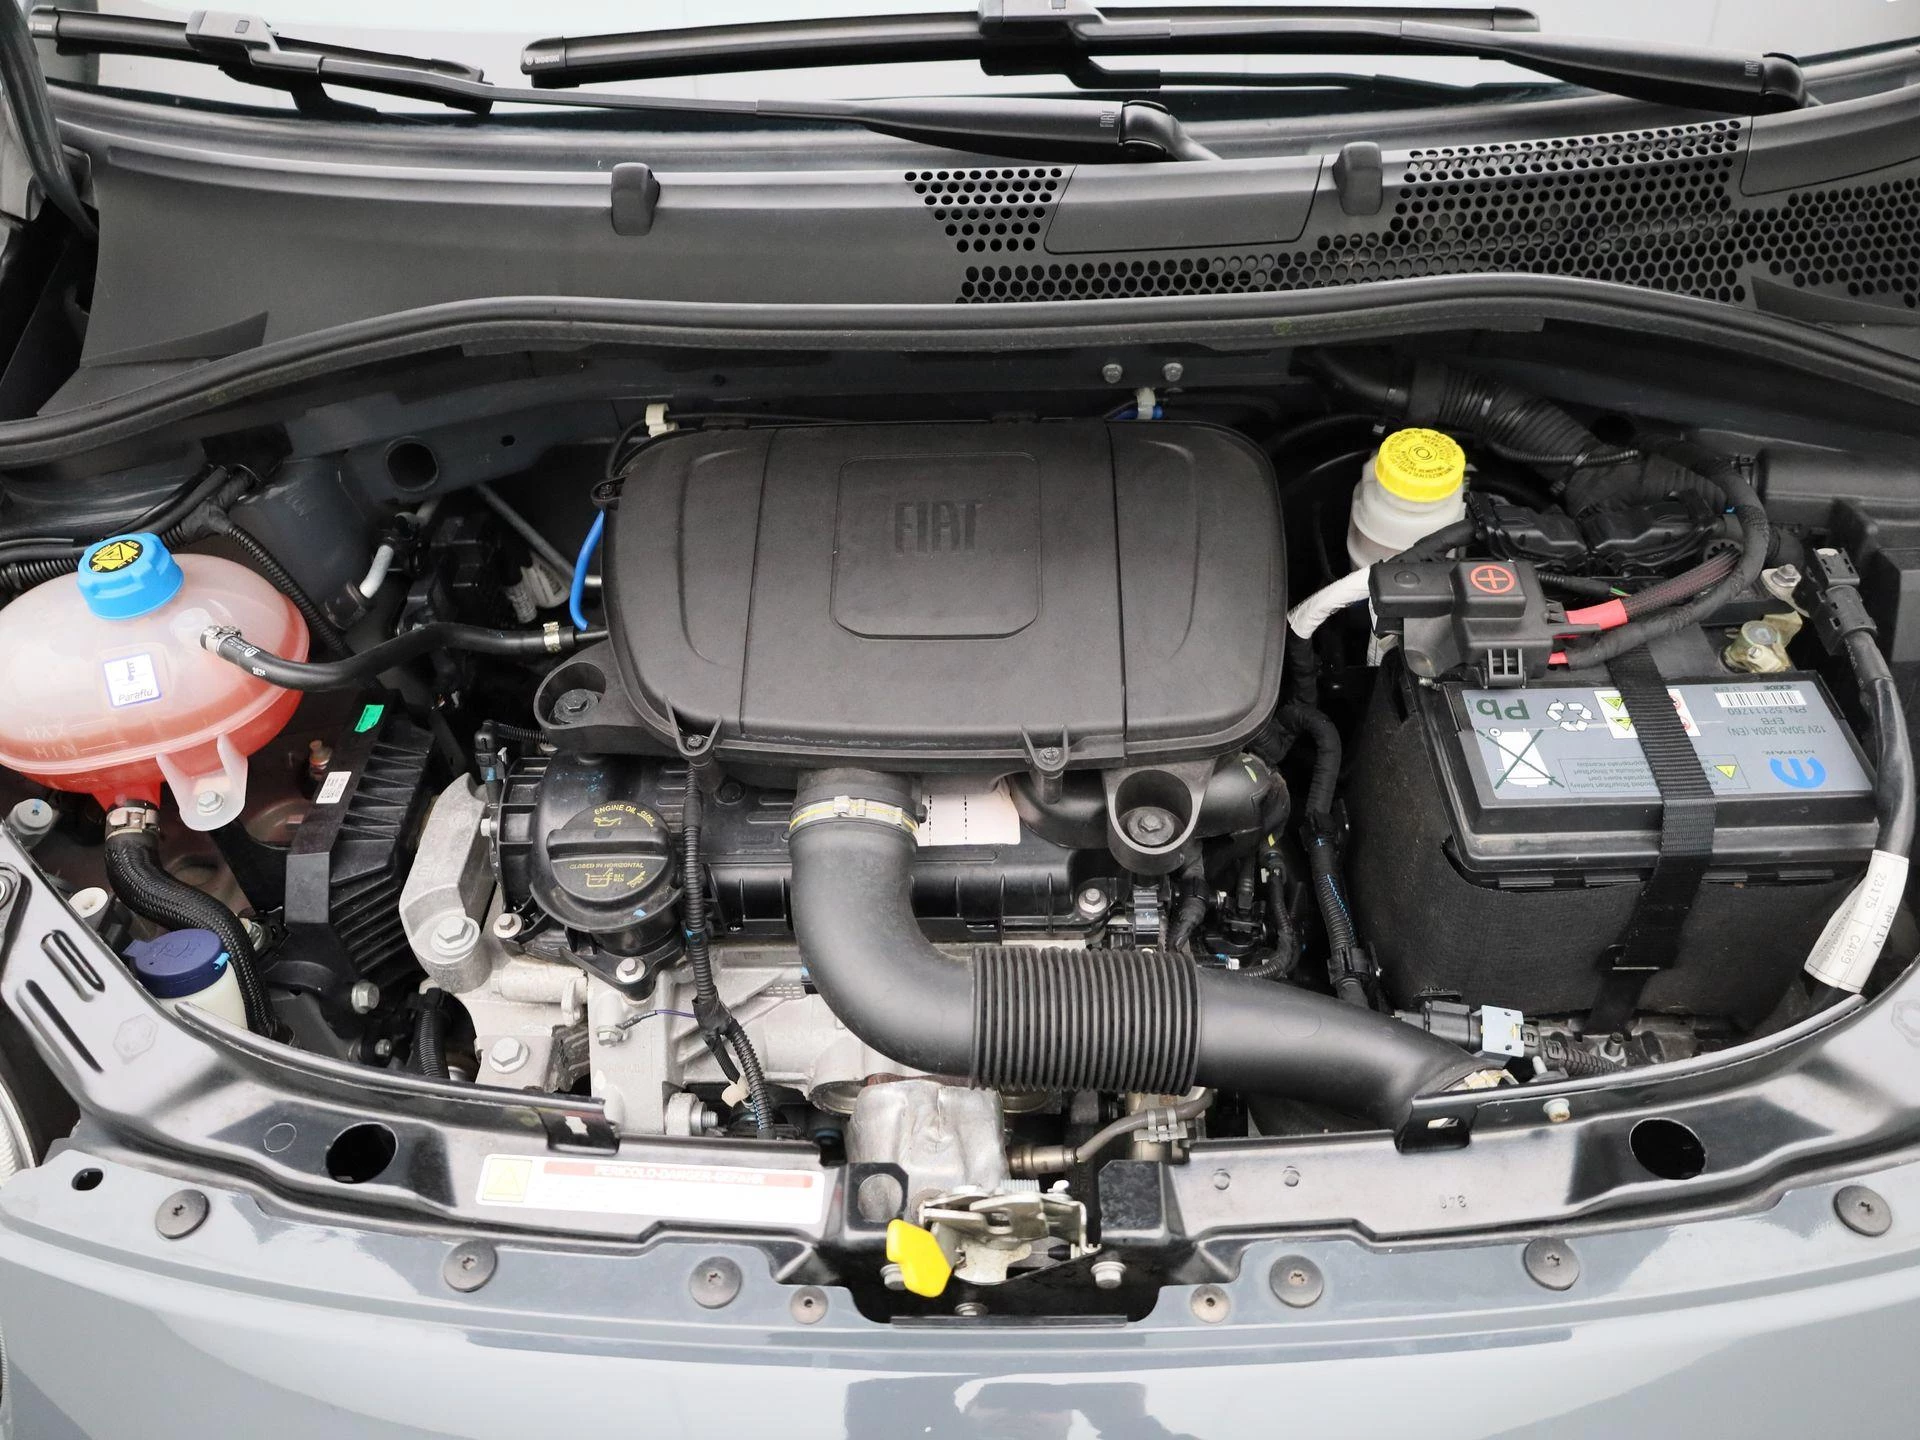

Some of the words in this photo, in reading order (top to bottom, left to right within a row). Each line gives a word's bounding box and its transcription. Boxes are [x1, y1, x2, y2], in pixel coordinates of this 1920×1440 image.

[894, 501, 983, 553] FIAT
[118, 688, 153, 703] Paraflu
[1476, 699, 1530, 721] Pb
[1760, 717, 1785, 725] EFB
[25, 722, 66, 740] MAX
[1753, 727, 1777, 735] 500A
[1779, 726, 1806, 735] 50Ah
[1807, 725, 1827, 734] 12V
[33, 743, 79, 758] MIN
[594, 804, 625, 815] ENGINE
[625, 806, 637, 814] OIL
[1873, 904, 1896, 948] APTIV
